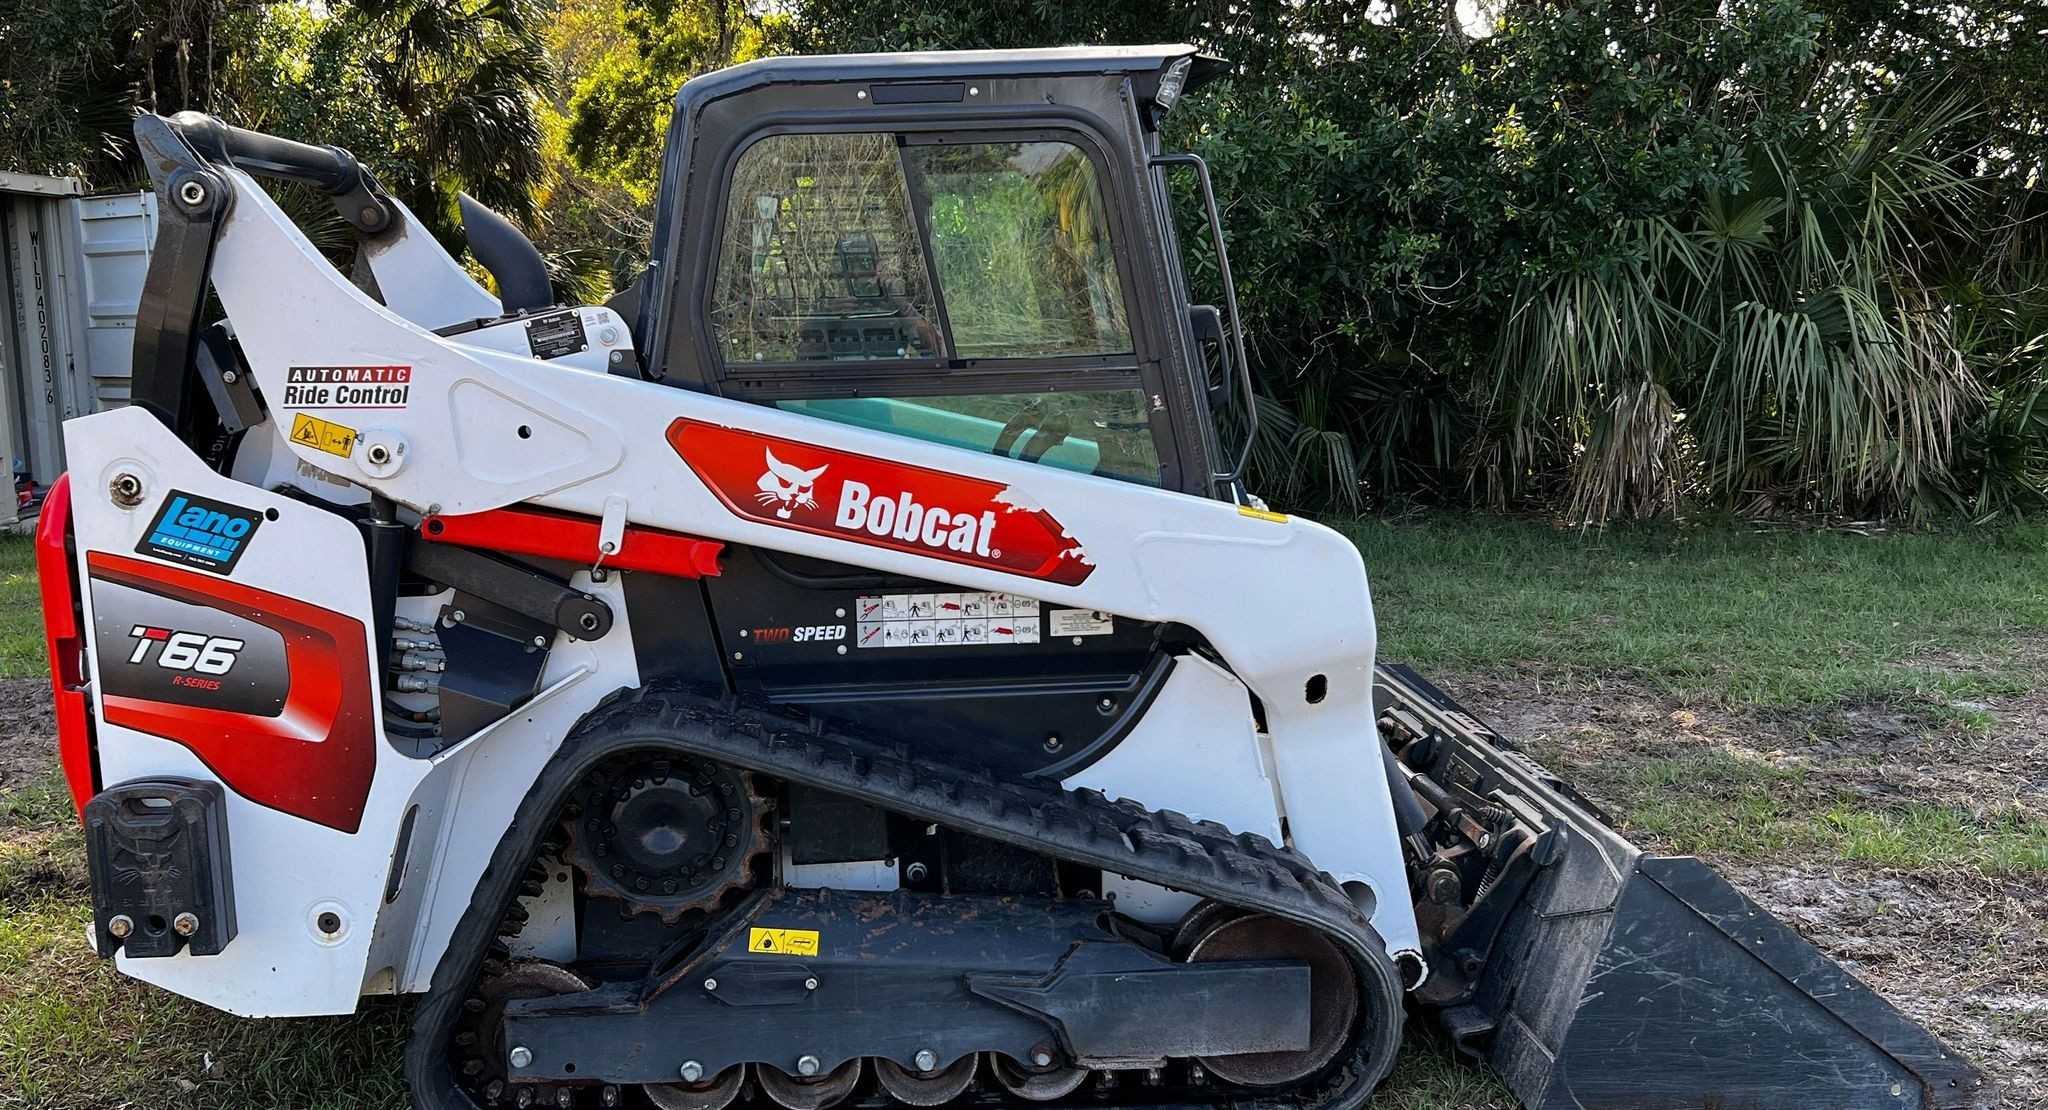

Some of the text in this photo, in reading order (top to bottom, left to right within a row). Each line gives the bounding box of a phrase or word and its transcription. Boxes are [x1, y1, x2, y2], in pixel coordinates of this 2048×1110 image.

[30, 231, 42, 290] WILU
[291, 369, 407, 382] AUTOMATIC
[284, 385, 409, 404] Ride Control
[156, 496, 251, 539] Lano
[835, 479, 997, 558] Bobcat
[160, 537, 221, 557] EQUIPMENT
[753, 625, 847, 643] TWO SPEED
[127, 624, 245, 676] T66
[172, 675, 222, 691] R-SERIES
